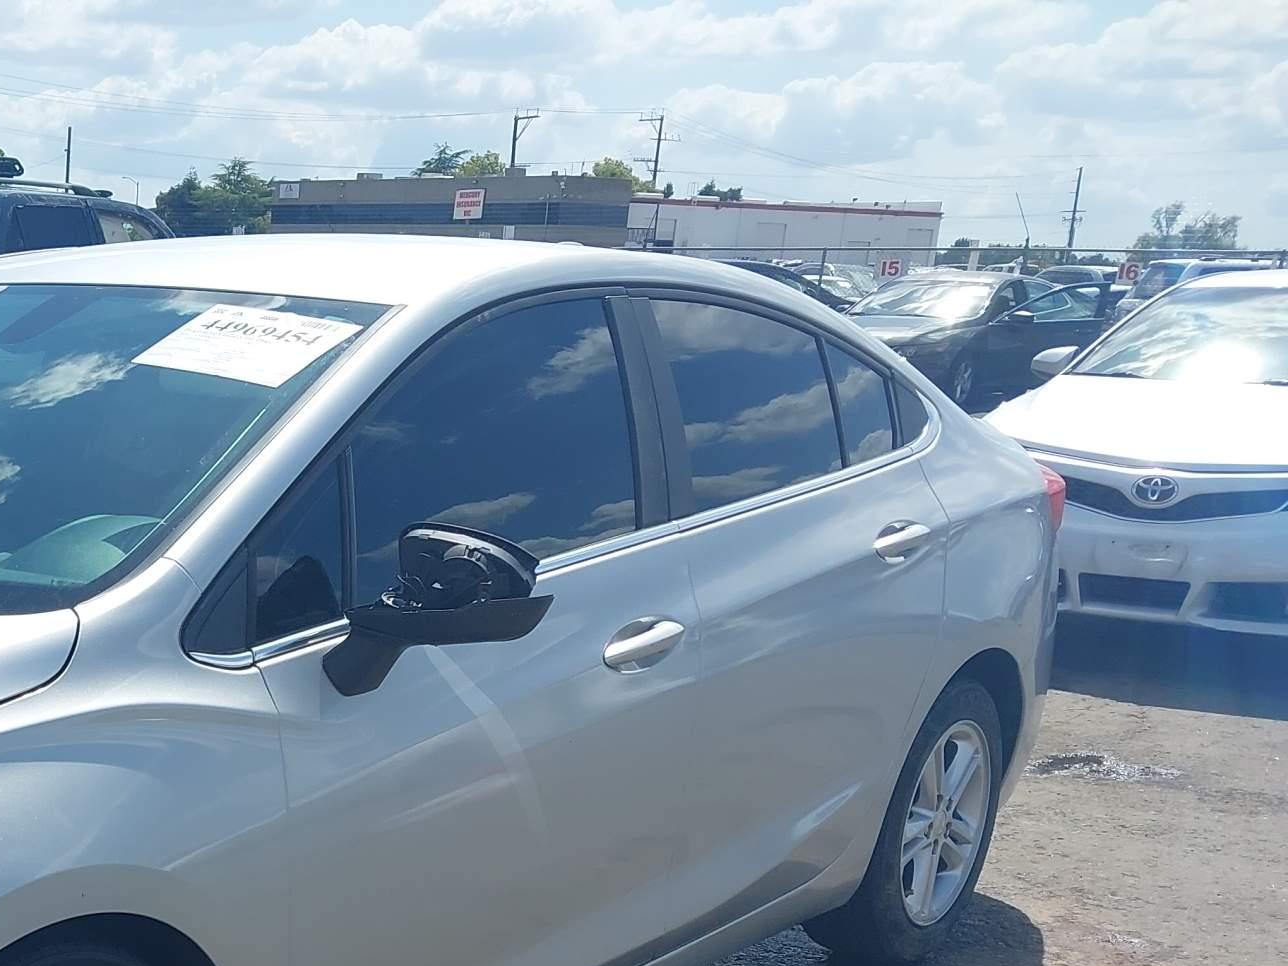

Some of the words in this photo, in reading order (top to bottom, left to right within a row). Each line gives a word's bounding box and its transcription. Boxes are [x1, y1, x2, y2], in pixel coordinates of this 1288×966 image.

[881, 261, 899, 276] 15
[1118, 263, 1139, 280] 16
[201, 319, 323, 346] 44969454
